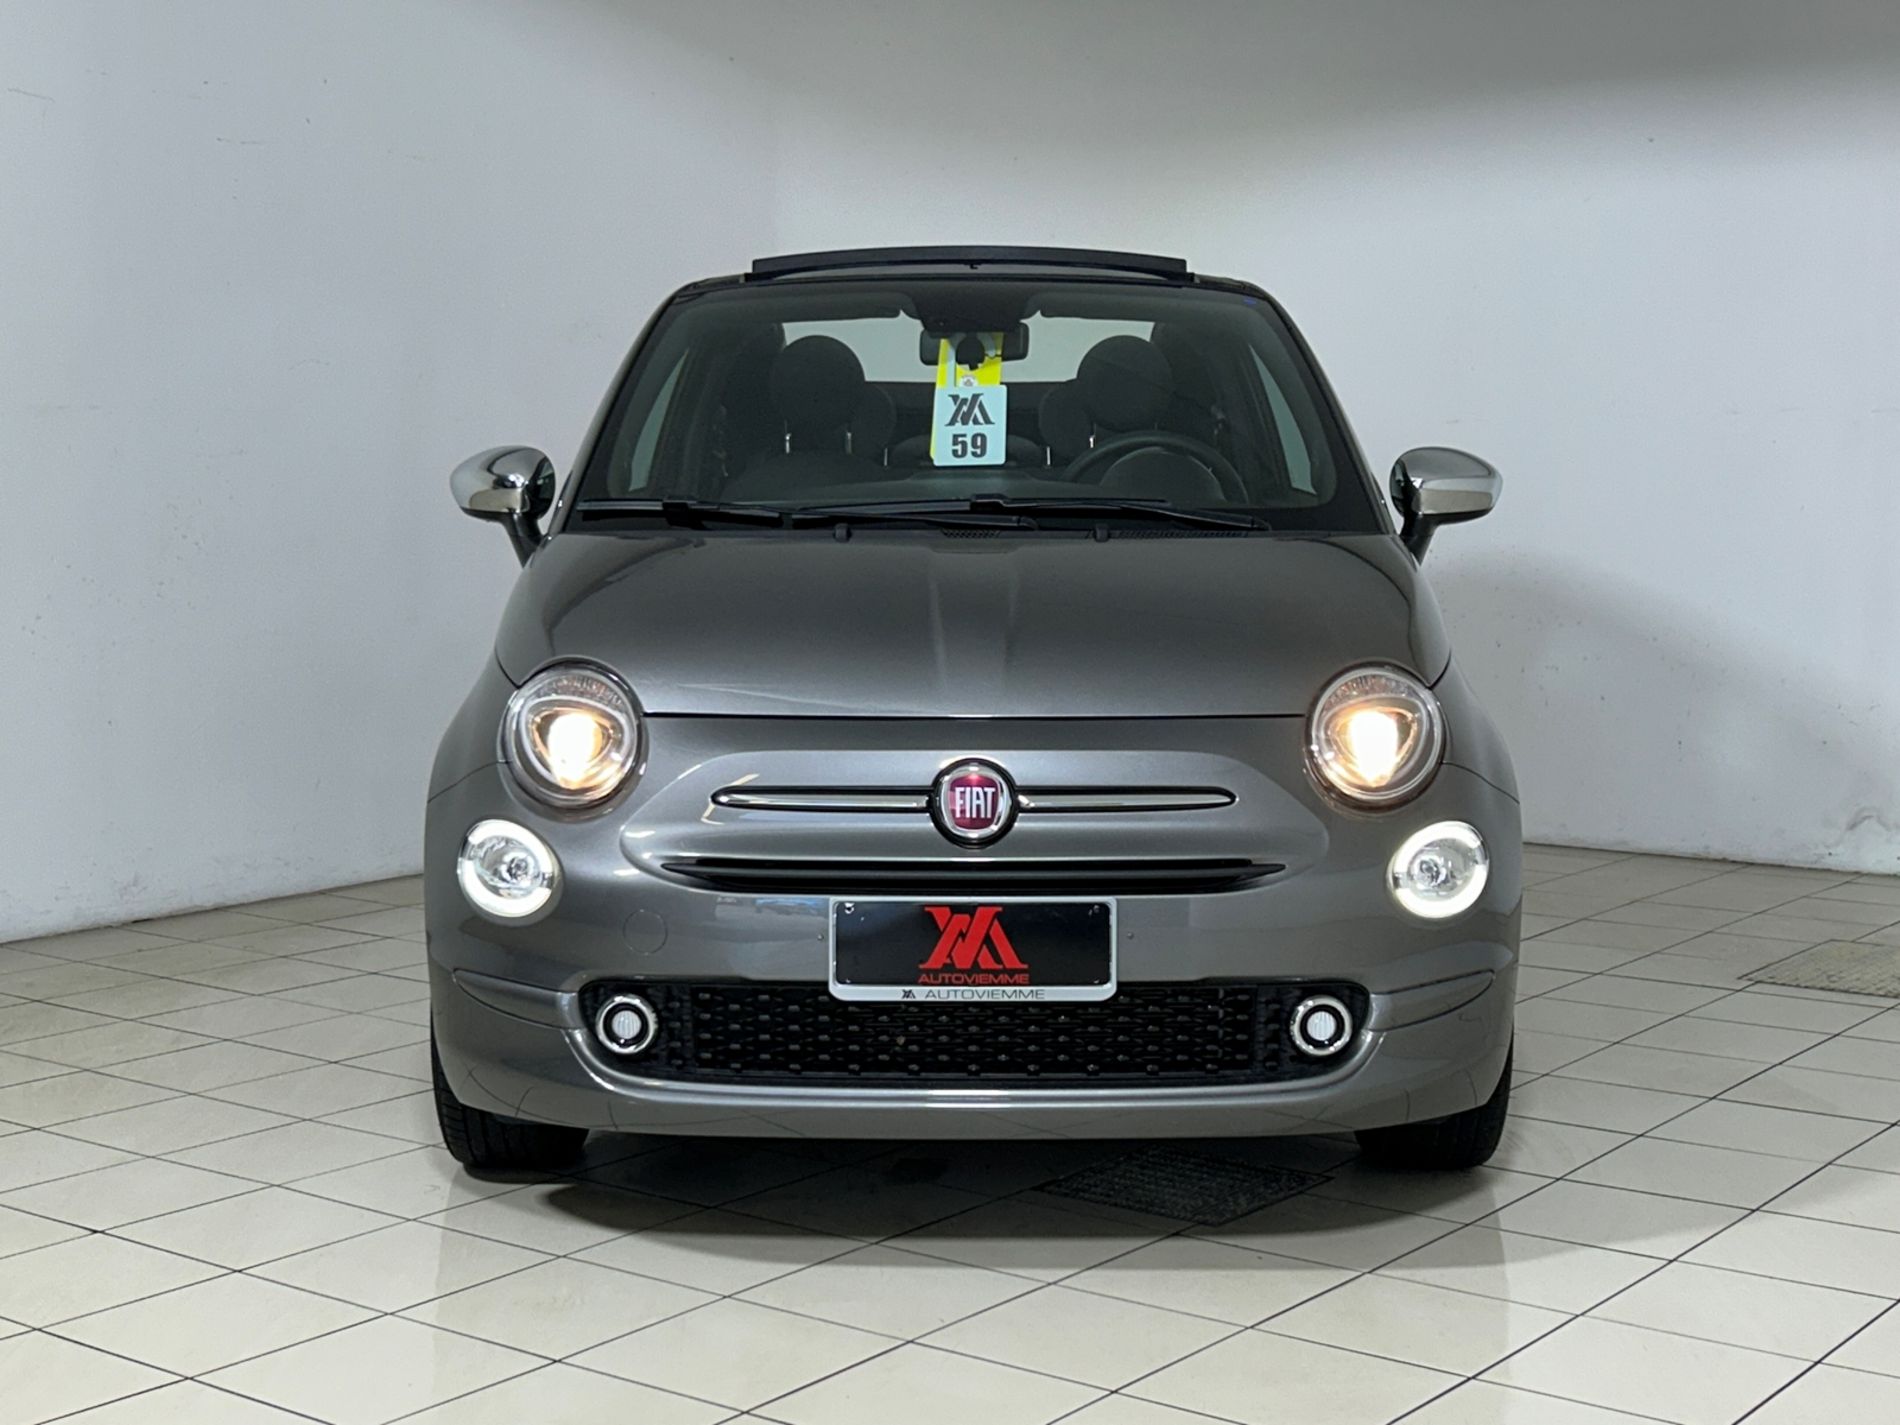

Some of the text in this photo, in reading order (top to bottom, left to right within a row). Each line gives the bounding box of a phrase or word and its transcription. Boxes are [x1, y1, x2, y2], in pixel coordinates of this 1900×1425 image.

[952, 432, 988, 459] 59
[955, 787, 996, 818] FIAT
[918, 974, 1029, 985] AUTOVIEMME
[924, 989, 1045, 1000] AUTOVIEMME
